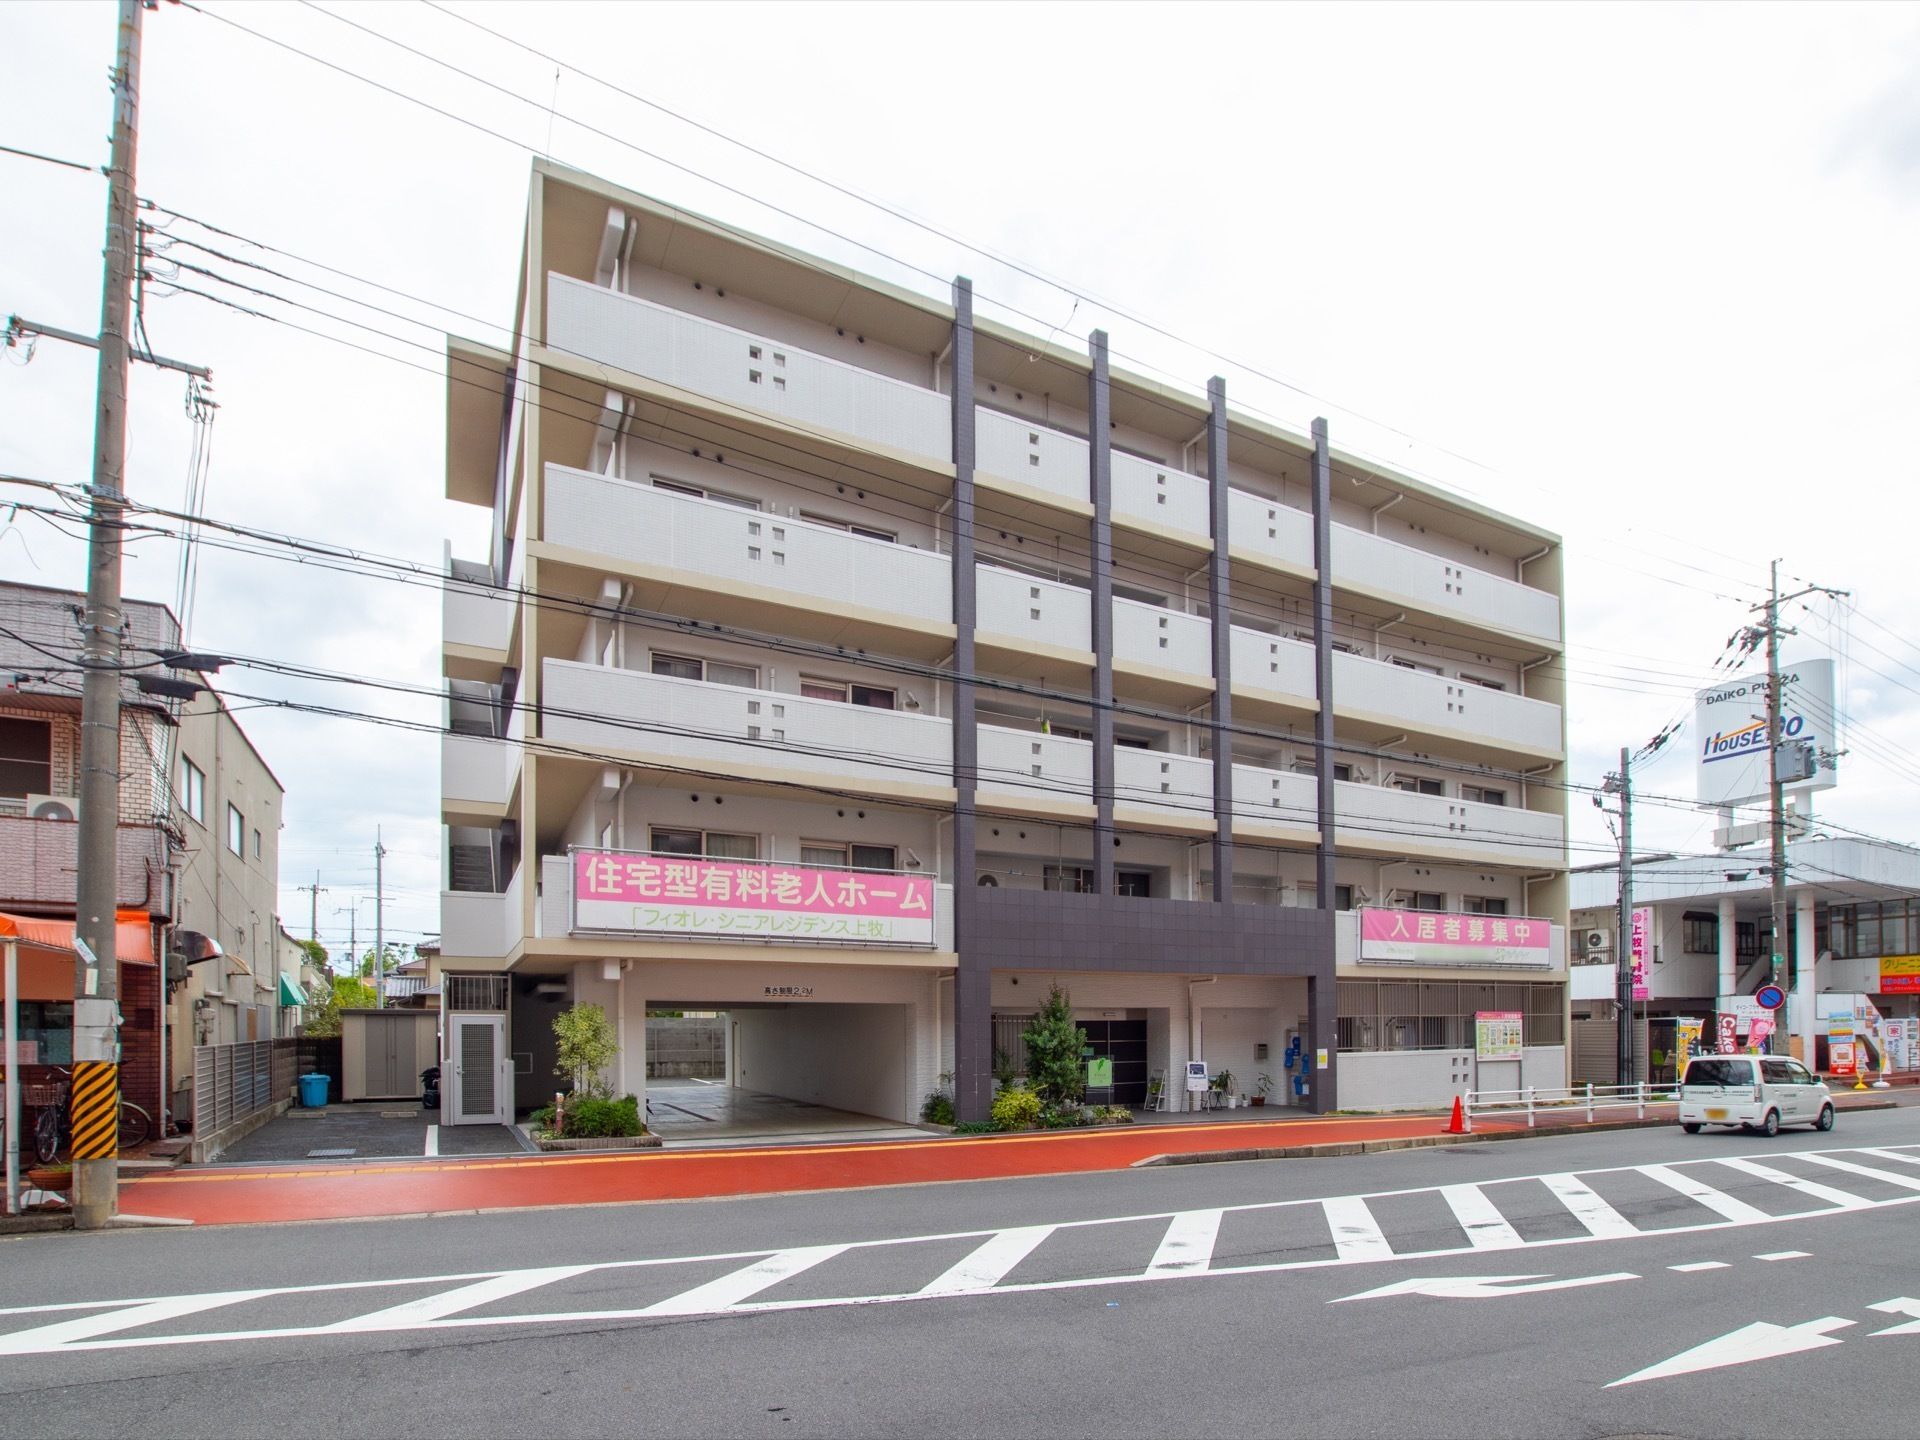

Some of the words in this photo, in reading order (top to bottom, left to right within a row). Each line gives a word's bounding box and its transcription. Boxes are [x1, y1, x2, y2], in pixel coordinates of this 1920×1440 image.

[1706, 687, 1746, 705] DAIKO
[1752, 673, 1800, 693] PLZA
[585, 857, 927, 912] 住宅型有料老人ホーム
[1390, 915, 1531, 944] 入居者募集中
[1722, 1016, 1736, 1053] Cake
